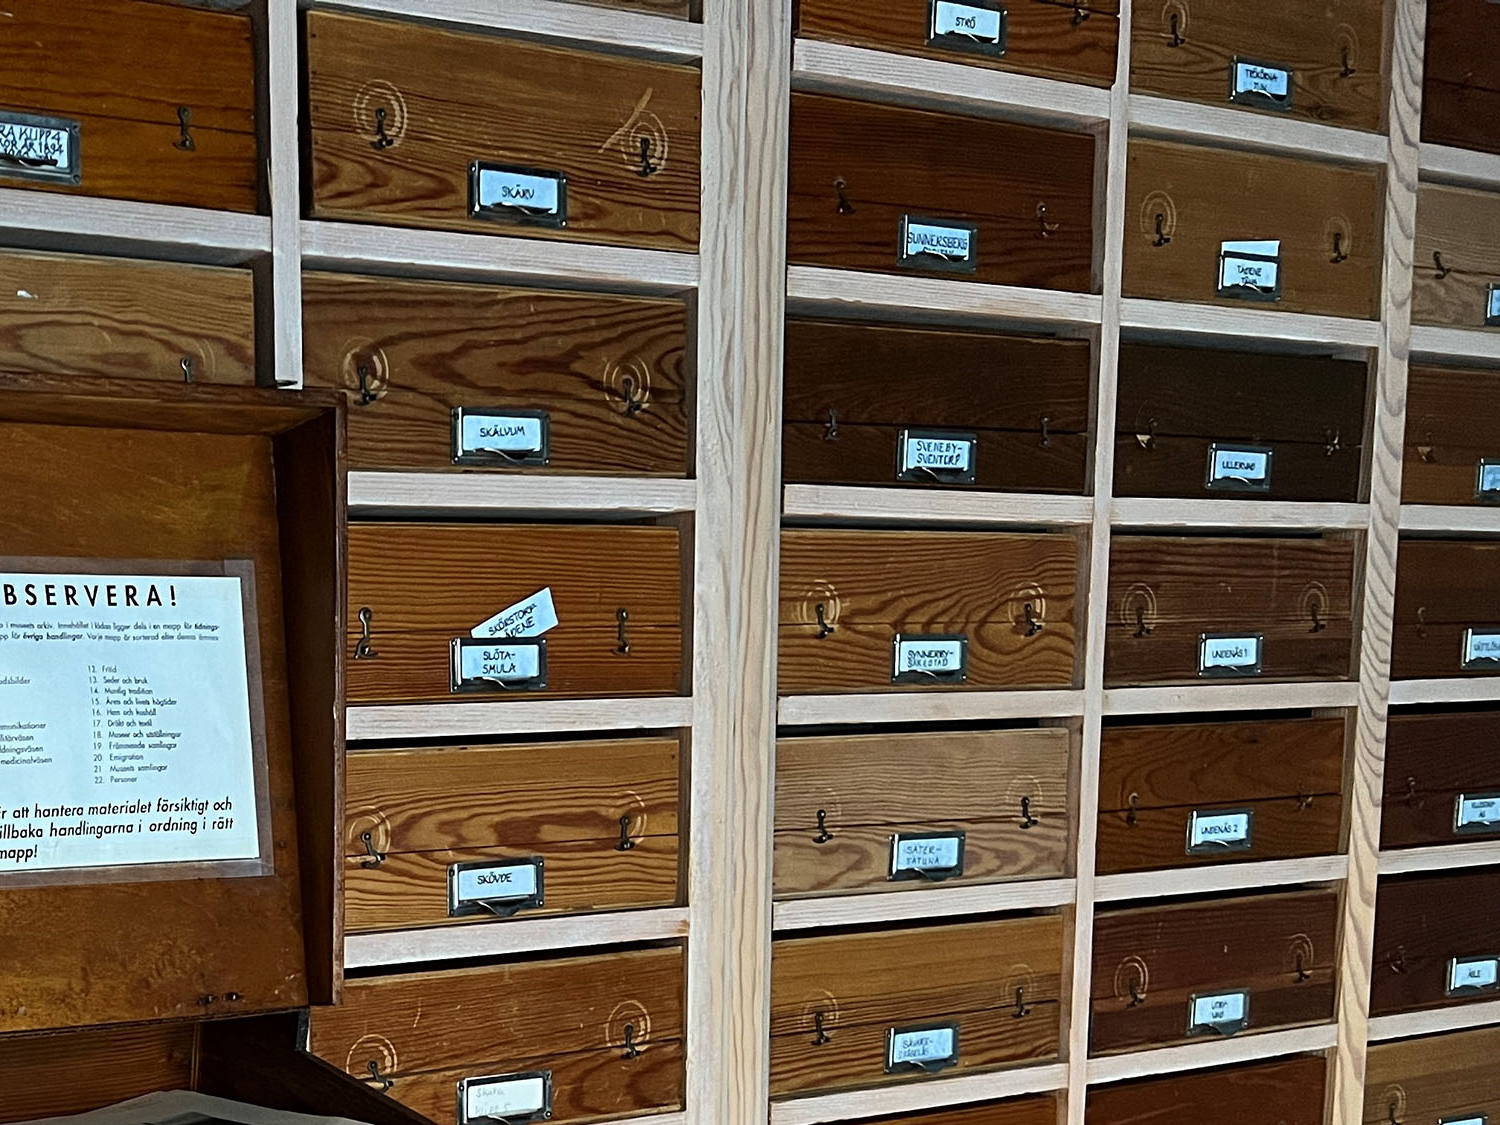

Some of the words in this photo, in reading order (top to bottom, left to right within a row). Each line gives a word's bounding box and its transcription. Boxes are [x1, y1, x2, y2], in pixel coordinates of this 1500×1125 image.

[955, 16, 976, 29] STRÖ
[19, 129, 51, 143] KLIPP
[501, 184, 535, 200] SKÄRV
[479, 424, 525, 438] SKÄLVUM
[482, 648, 516, 661] SLÖTA-
[482, 663, 516, 675] SMULA
[12, 807, 29, 819] att
[34, 803, 84, 819] hantera
[88, 798, 152, 816] materialet
[156, 797, 209, 816] försiktigt
[213, 796, 232, 811] och
[49, 820, 134, 839] handlingarna
[149, 816, 198, 835] ordning
[212, 817, 233, 830] rätt
[477, 871, 513, 885] SKÖVDE
